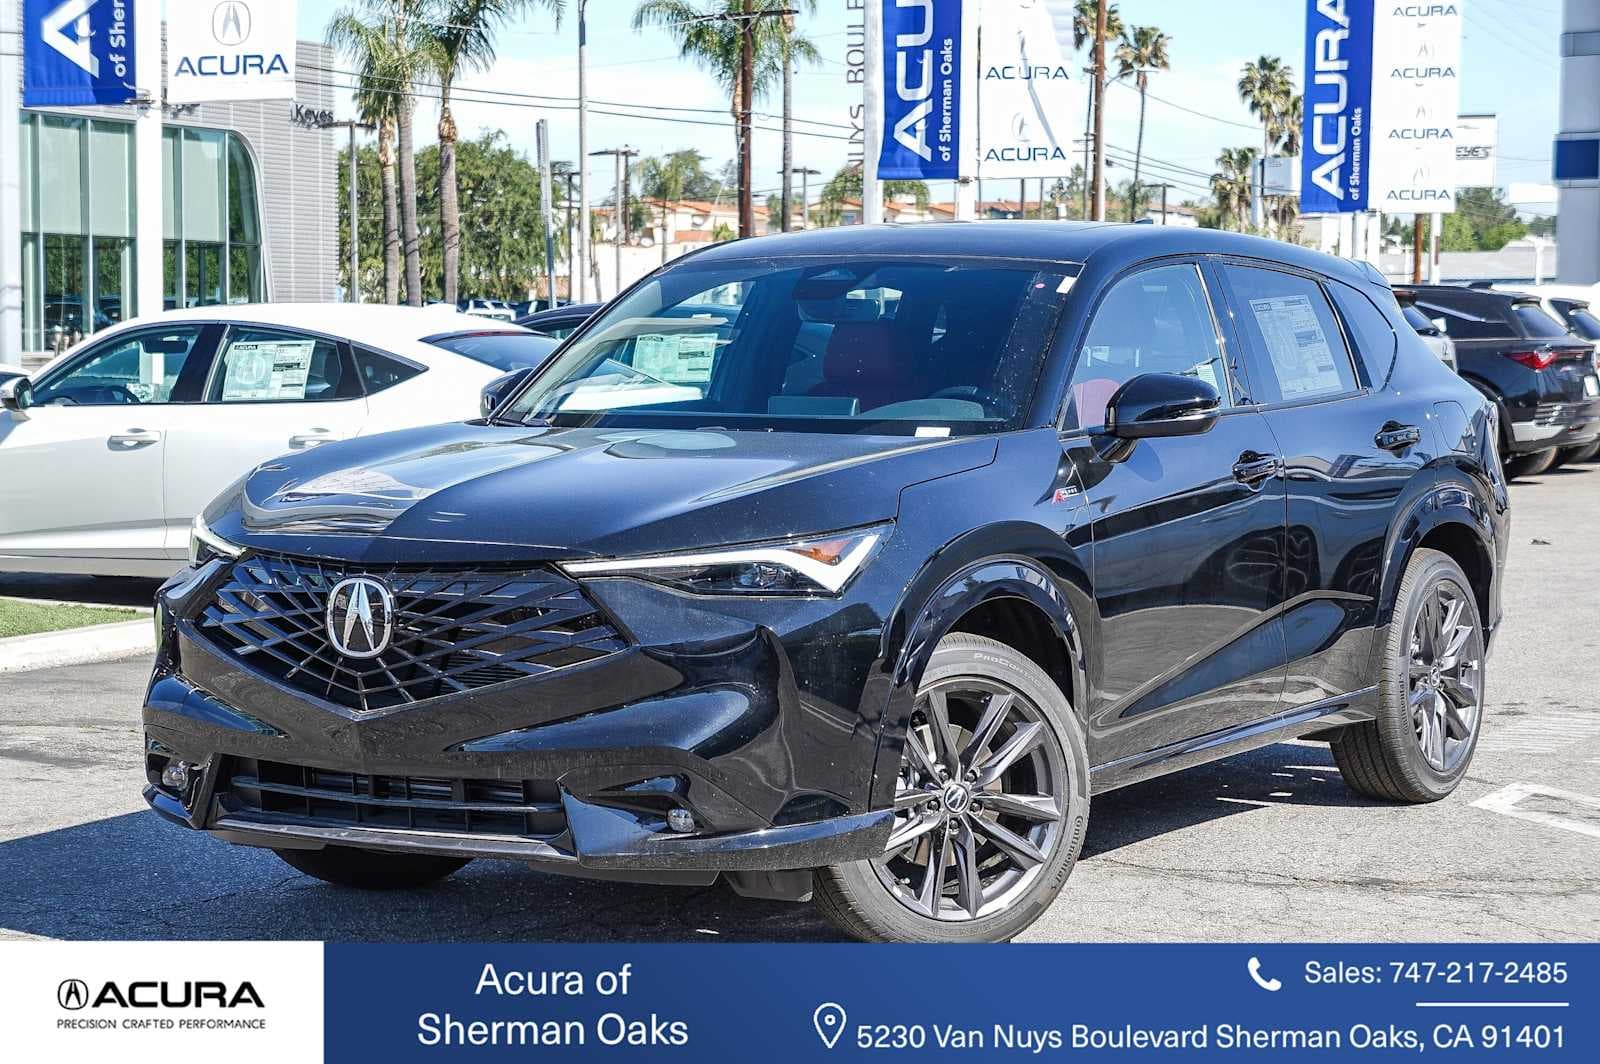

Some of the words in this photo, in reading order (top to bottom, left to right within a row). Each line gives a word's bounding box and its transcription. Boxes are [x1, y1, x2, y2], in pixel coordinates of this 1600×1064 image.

[1392, 4, 1458, 17] ACURA
[109, 52, 127, 78] of
[174, 54, 289, 77] ACURA
[938, 38, 953, 76] Oaks
[893, 0, 934, 162] ACU
[985, 66, 1069, 80] ACURA
[1390, 67, 1456, 79] ACURA
[1311, 0, 1350, 201] ACURA
[938, 79, 953, 143] Sherman
[1351, 107, 1362, 136] Oaks
[1388, 128, 1453, 139] ACURA
[938, 145, 951, 162] of
[984, 147, 1066, 161] ACURA
[1349, 138, 1361, 186] Sherman
[1349, 187, 1360, 201] of
[1386, 190, 1451, 201] ACURA
